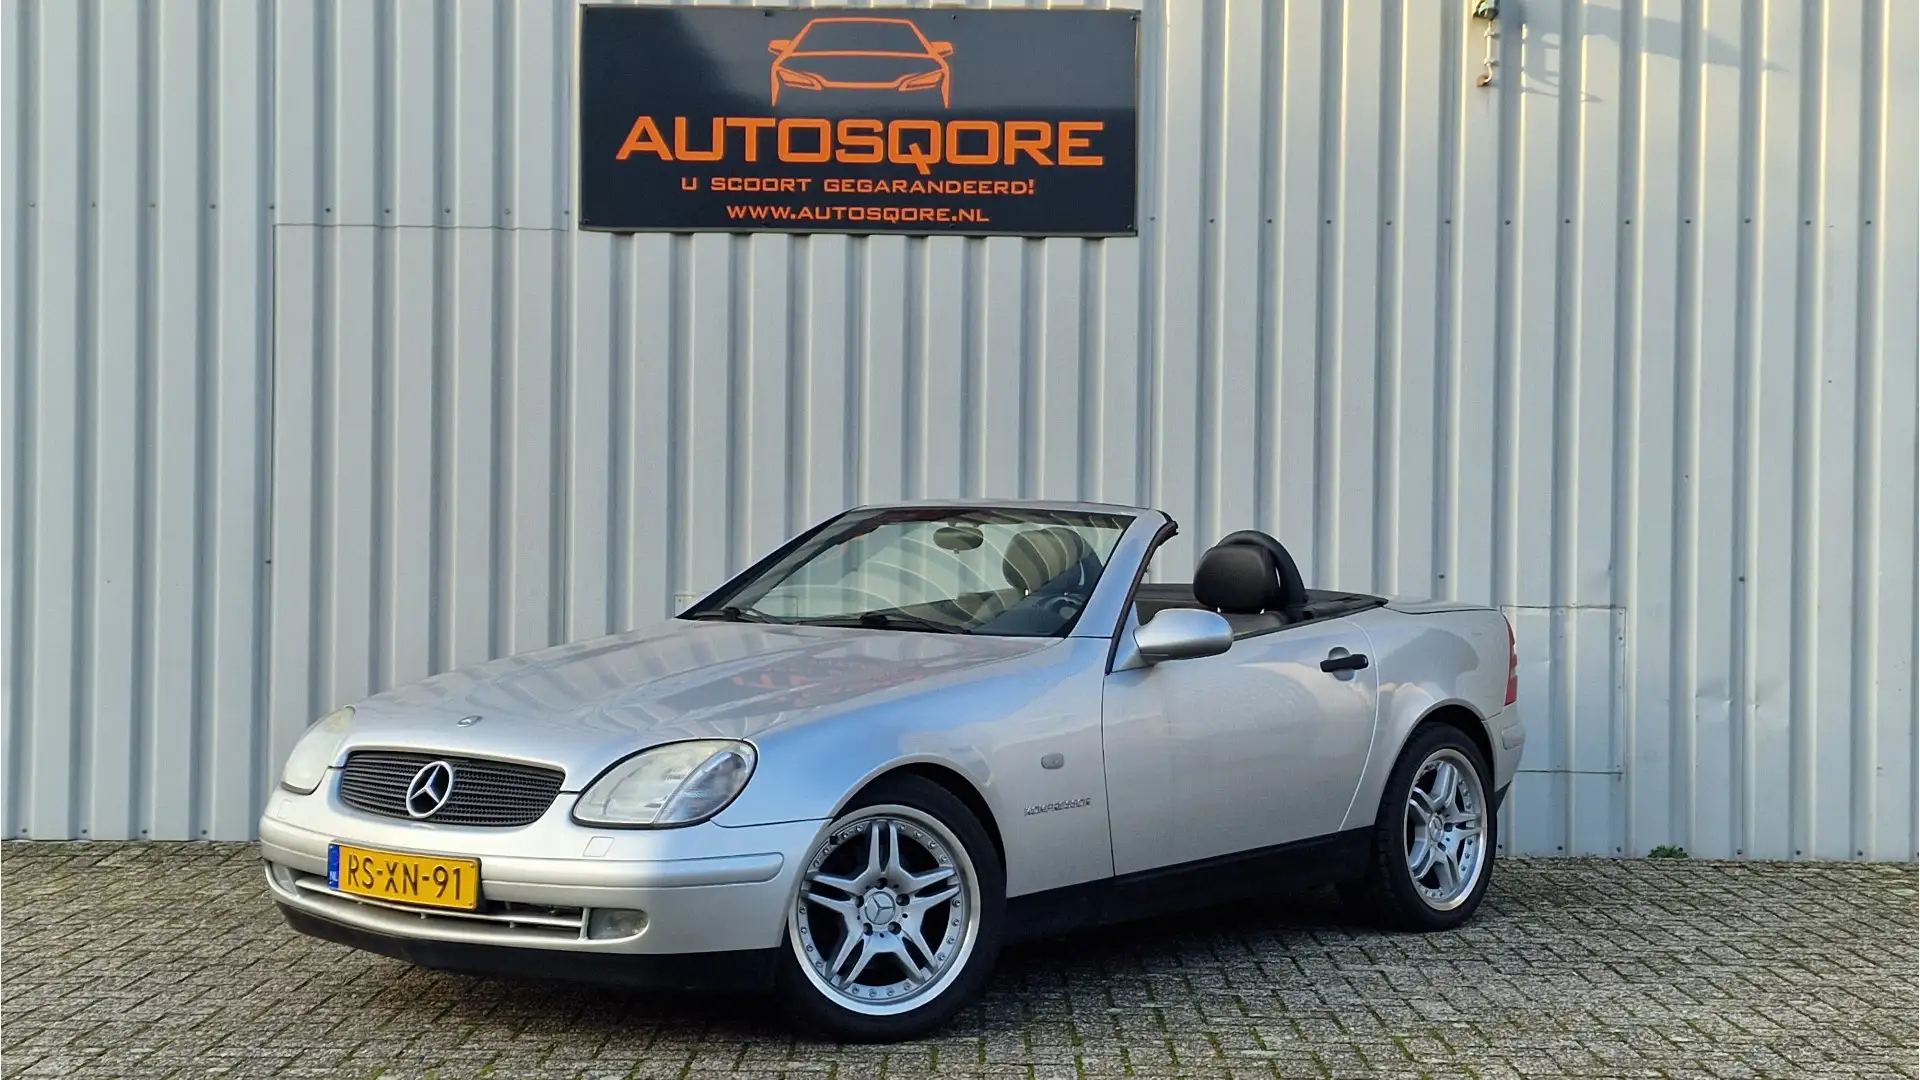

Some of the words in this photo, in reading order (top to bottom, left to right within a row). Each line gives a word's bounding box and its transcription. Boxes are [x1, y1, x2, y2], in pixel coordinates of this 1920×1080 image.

[616, 116, 1104, 174] AUTOSQORE
[680, 177, 700, 192] U
[711, 177, 812, 193] SCOORT
[823, 178, 1036, 196] GEGARANDEERD!
[727, 205, 989, 223] WWW.AUTOSQORE.NL
[329, 871, 338, 882] NL
[347, 854, 461, 900] RS-XN-91
